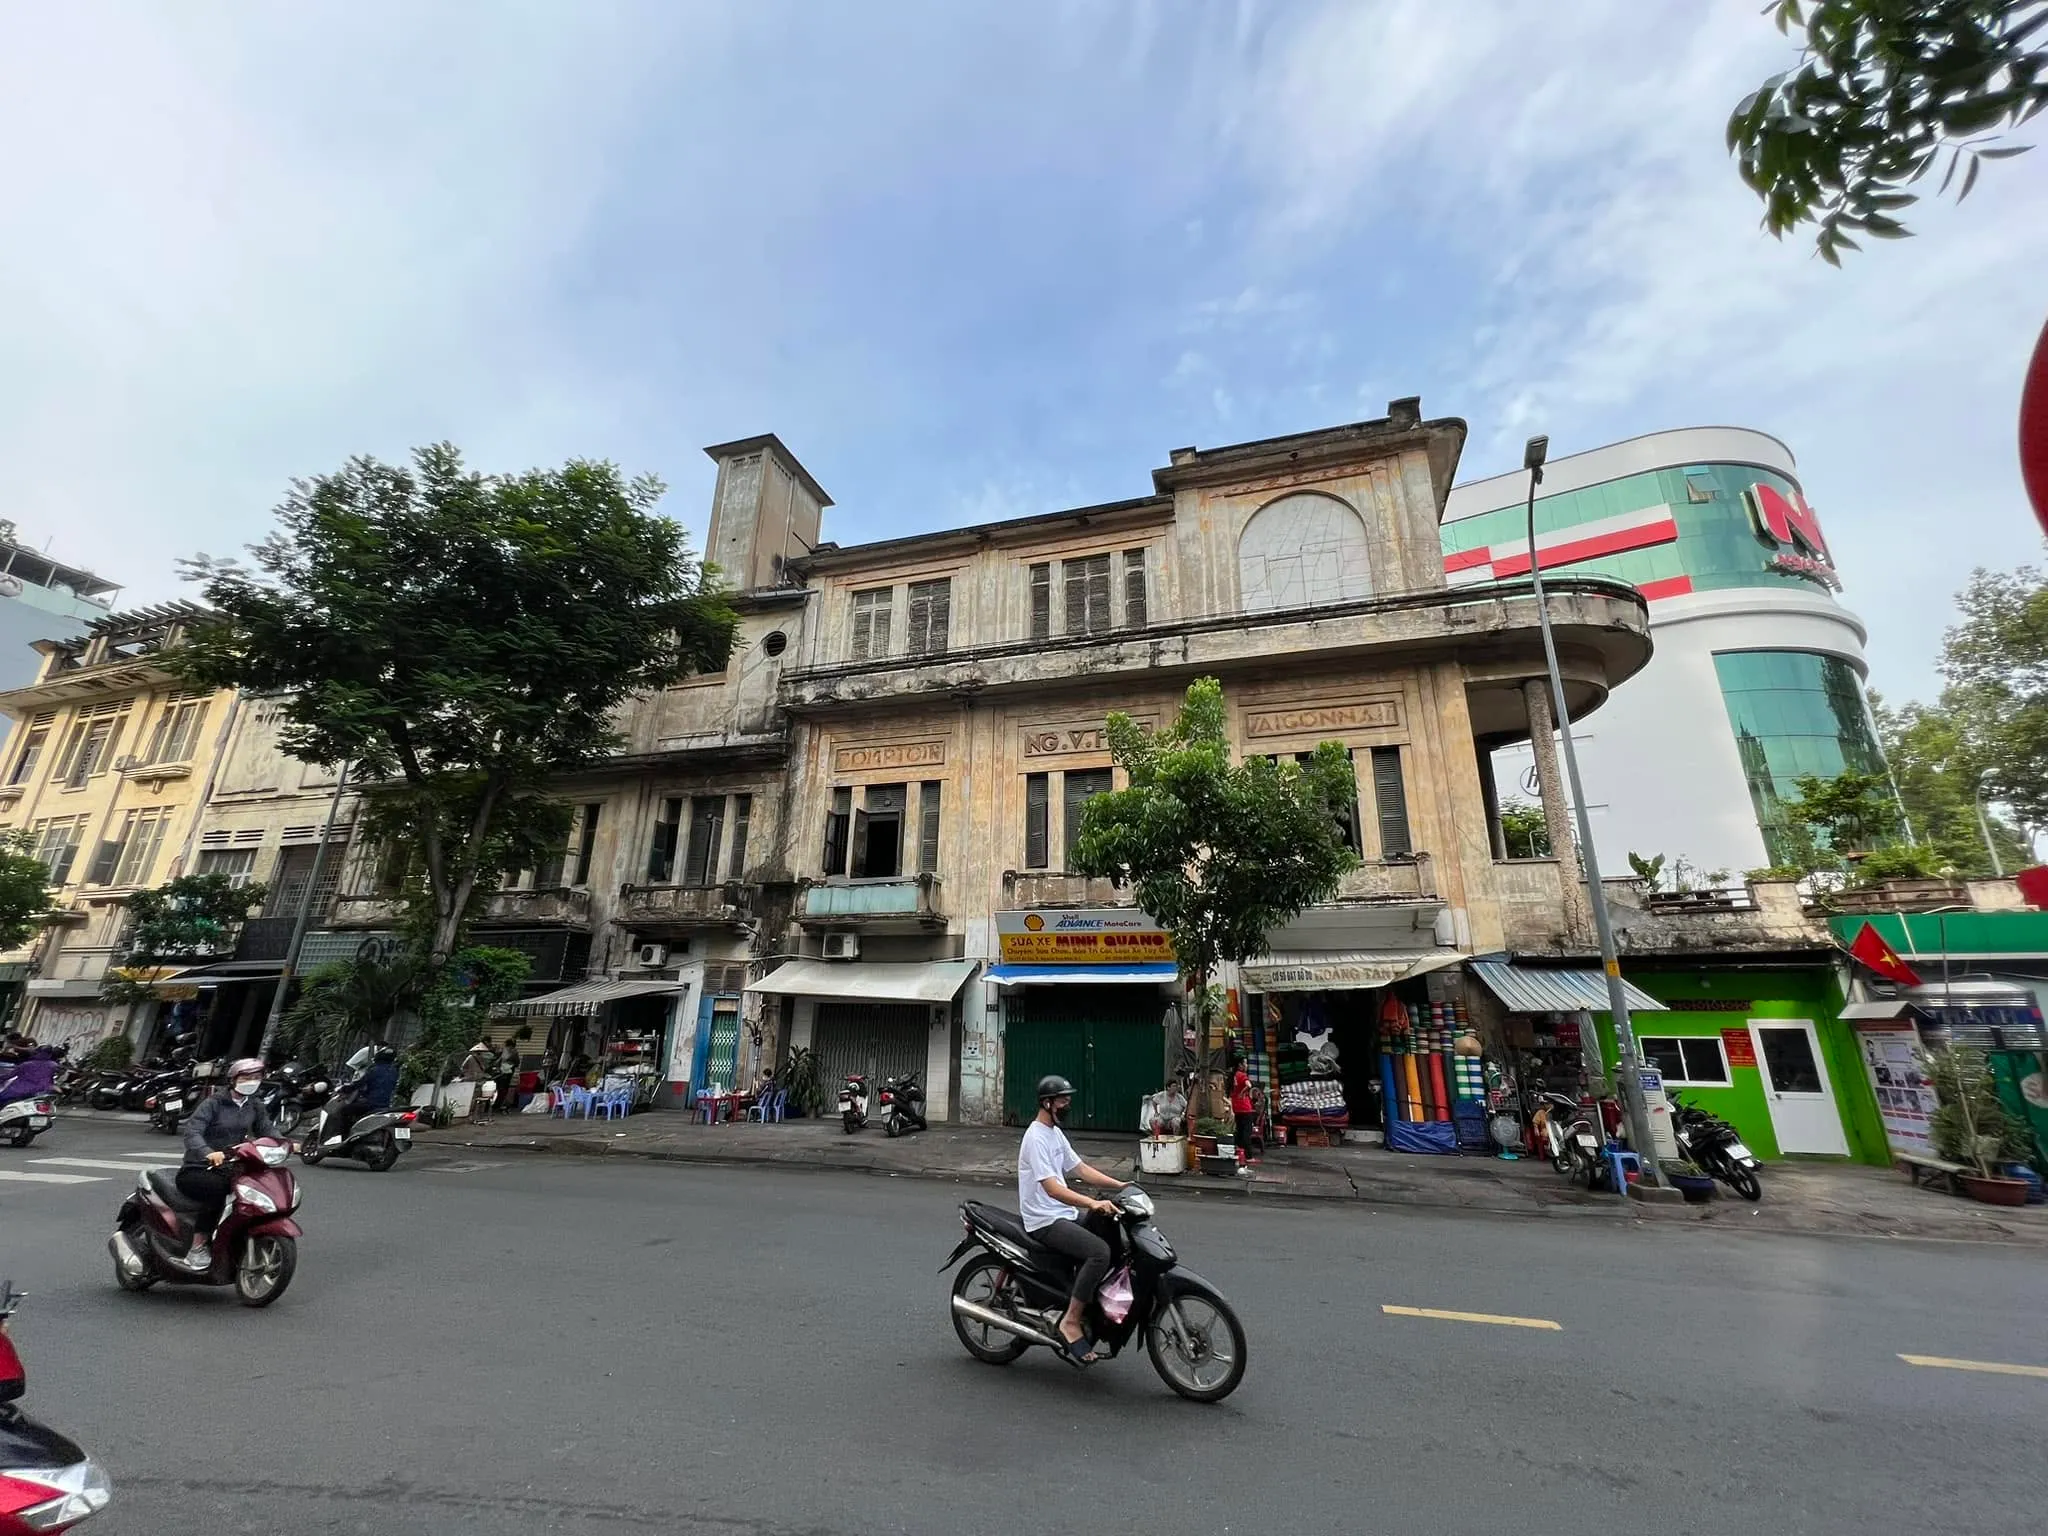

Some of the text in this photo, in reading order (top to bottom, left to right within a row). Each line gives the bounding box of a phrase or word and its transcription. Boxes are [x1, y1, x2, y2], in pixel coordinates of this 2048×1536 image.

[1055, 919, 1103, 928] ADVANCE
[1037, 936, 1051, 947] XE
[1056, 935, 1098, 947] MINH
